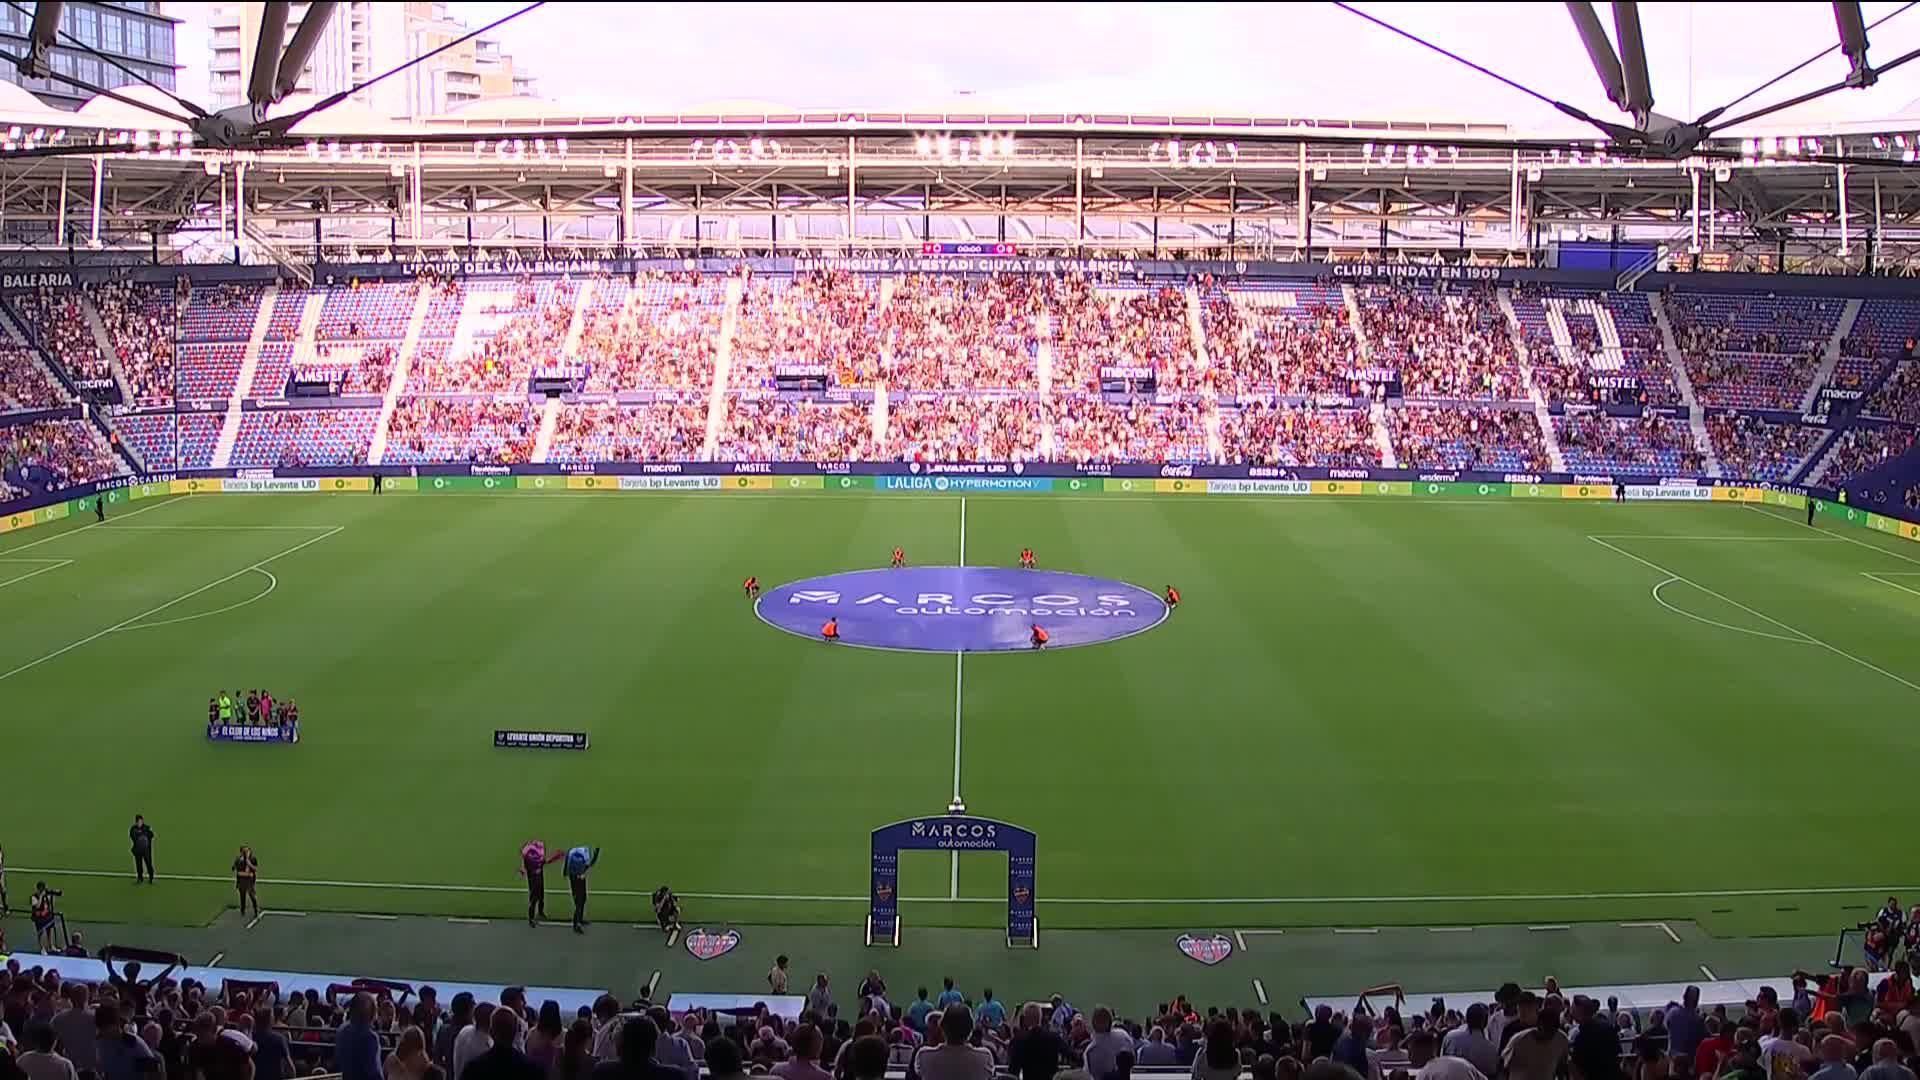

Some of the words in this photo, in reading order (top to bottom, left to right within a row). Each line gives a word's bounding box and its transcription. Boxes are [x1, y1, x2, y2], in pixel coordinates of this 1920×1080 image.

[464, 262, 501, 274] DELS
[506, 261, 601, 273] VALENCIANS
[893, 260, 905, 272] A
[909, 260, 974, 272] L'ESTADI
[978, 260, 1031, 272] CIUTAT
[1035, 260, 1056, 272] DE
[1333, 264, 1373, 277] CLUB
[1376, 265, 1438, 278] FUNDAT
[1441, 266, 1461, 279] EN
[1465, 267, 1501, 280] 1909
[1101, 366, 1153, 379] macron
[1345, 369, 1397, 382] AMSTEL
[1589, 376, 1639, 389] AMSTEL
[643, 464, 682, 473] macron
[734, 464, 772, 473] AMSTEL
[926, 464, 985, 474] LEVANTE
[1329, 468, 1369, 480] macron
[250, 479, 263, 491] bp
[264, 480, 299, 490] Levante
[301, 480, 317, 490] UD
[649, 477, 662, 489] bp
[663, 477, 700, 489] Levante
[703, 477, 718, 488] UD
[888, 476, 932, 490] LALIGA
[951, 479, 1032, 489] HYPERMOTION
[1238, 481, 1251, 493] bp
[1252, 481, 1290, 492] Levante
[1292, 482, 1308, 492] UD
[1642, 487, 1655, 500] bp
[1655, 486, 1691, 498] Levante
[1693, 487, 1709, 498] UD
[788, 591, 1131, 606] MARCOS
[895, 604, 1137, 617] automoción
[911, 822, 996, 838] MARCOS
[938, 839, 996, 849] automoción
